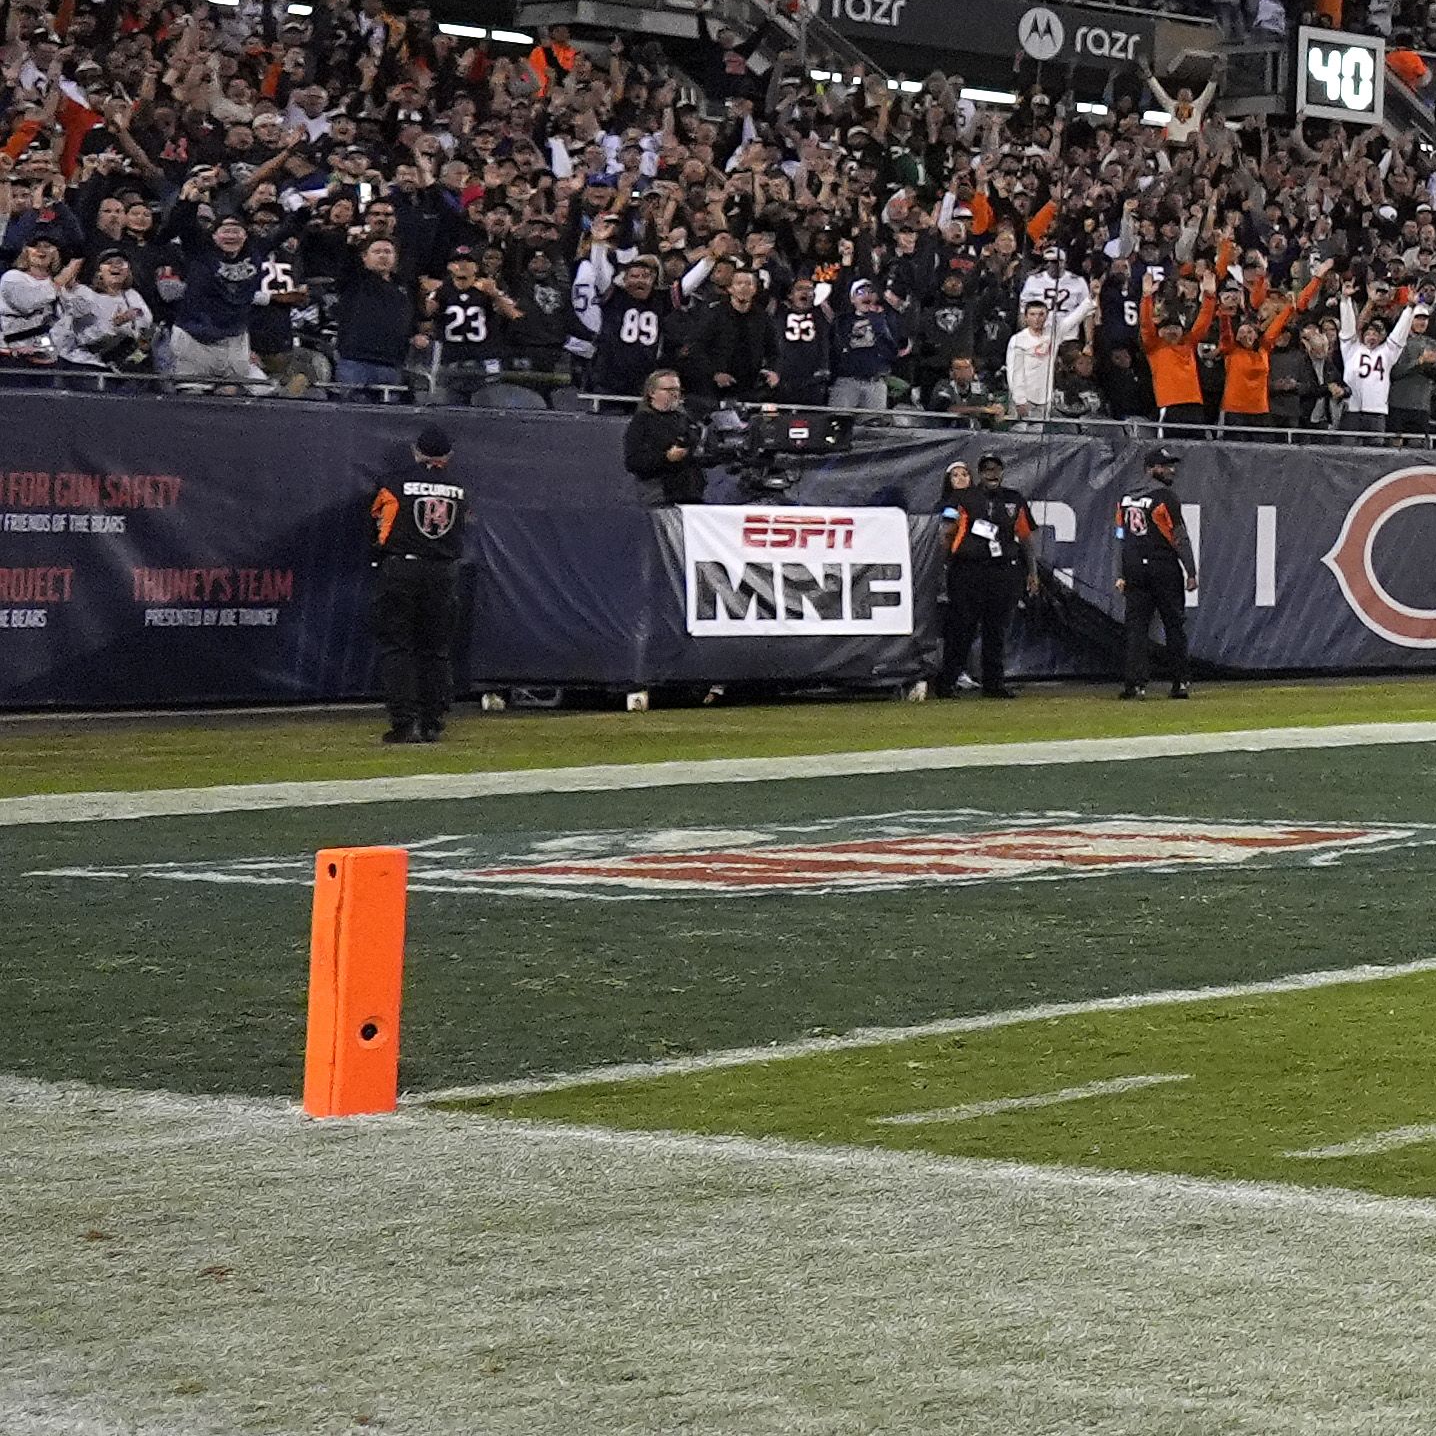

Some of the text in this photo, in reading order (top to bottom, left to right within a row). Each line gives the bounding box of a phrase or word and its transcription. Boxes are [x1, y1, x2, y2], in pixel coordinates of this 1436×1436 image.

[1074, 24, 1141, 61] razr
[1307, 46, 1374, 111] 40
[260, 262, 295, 296] 25
[1043, 288, 1070, 313] 52
[444, 305, 488, 343] 23
[619, 308, 659, 346] 89
[1359, 354, 1384, 381] 54
[8, 471, 185, 509] FOR GUN SAFETY
[403, 481, 464, 500] SECURITY
[69, 514, 90, 533] THE
[90, 514, 126, 534] BEARS
[743, 514, 856, 550] ESPN
[0, 565, 73, 602] ROJECT
[239, 567, 294, 602] TEAM
[694, 560, 902, 622] MNF
